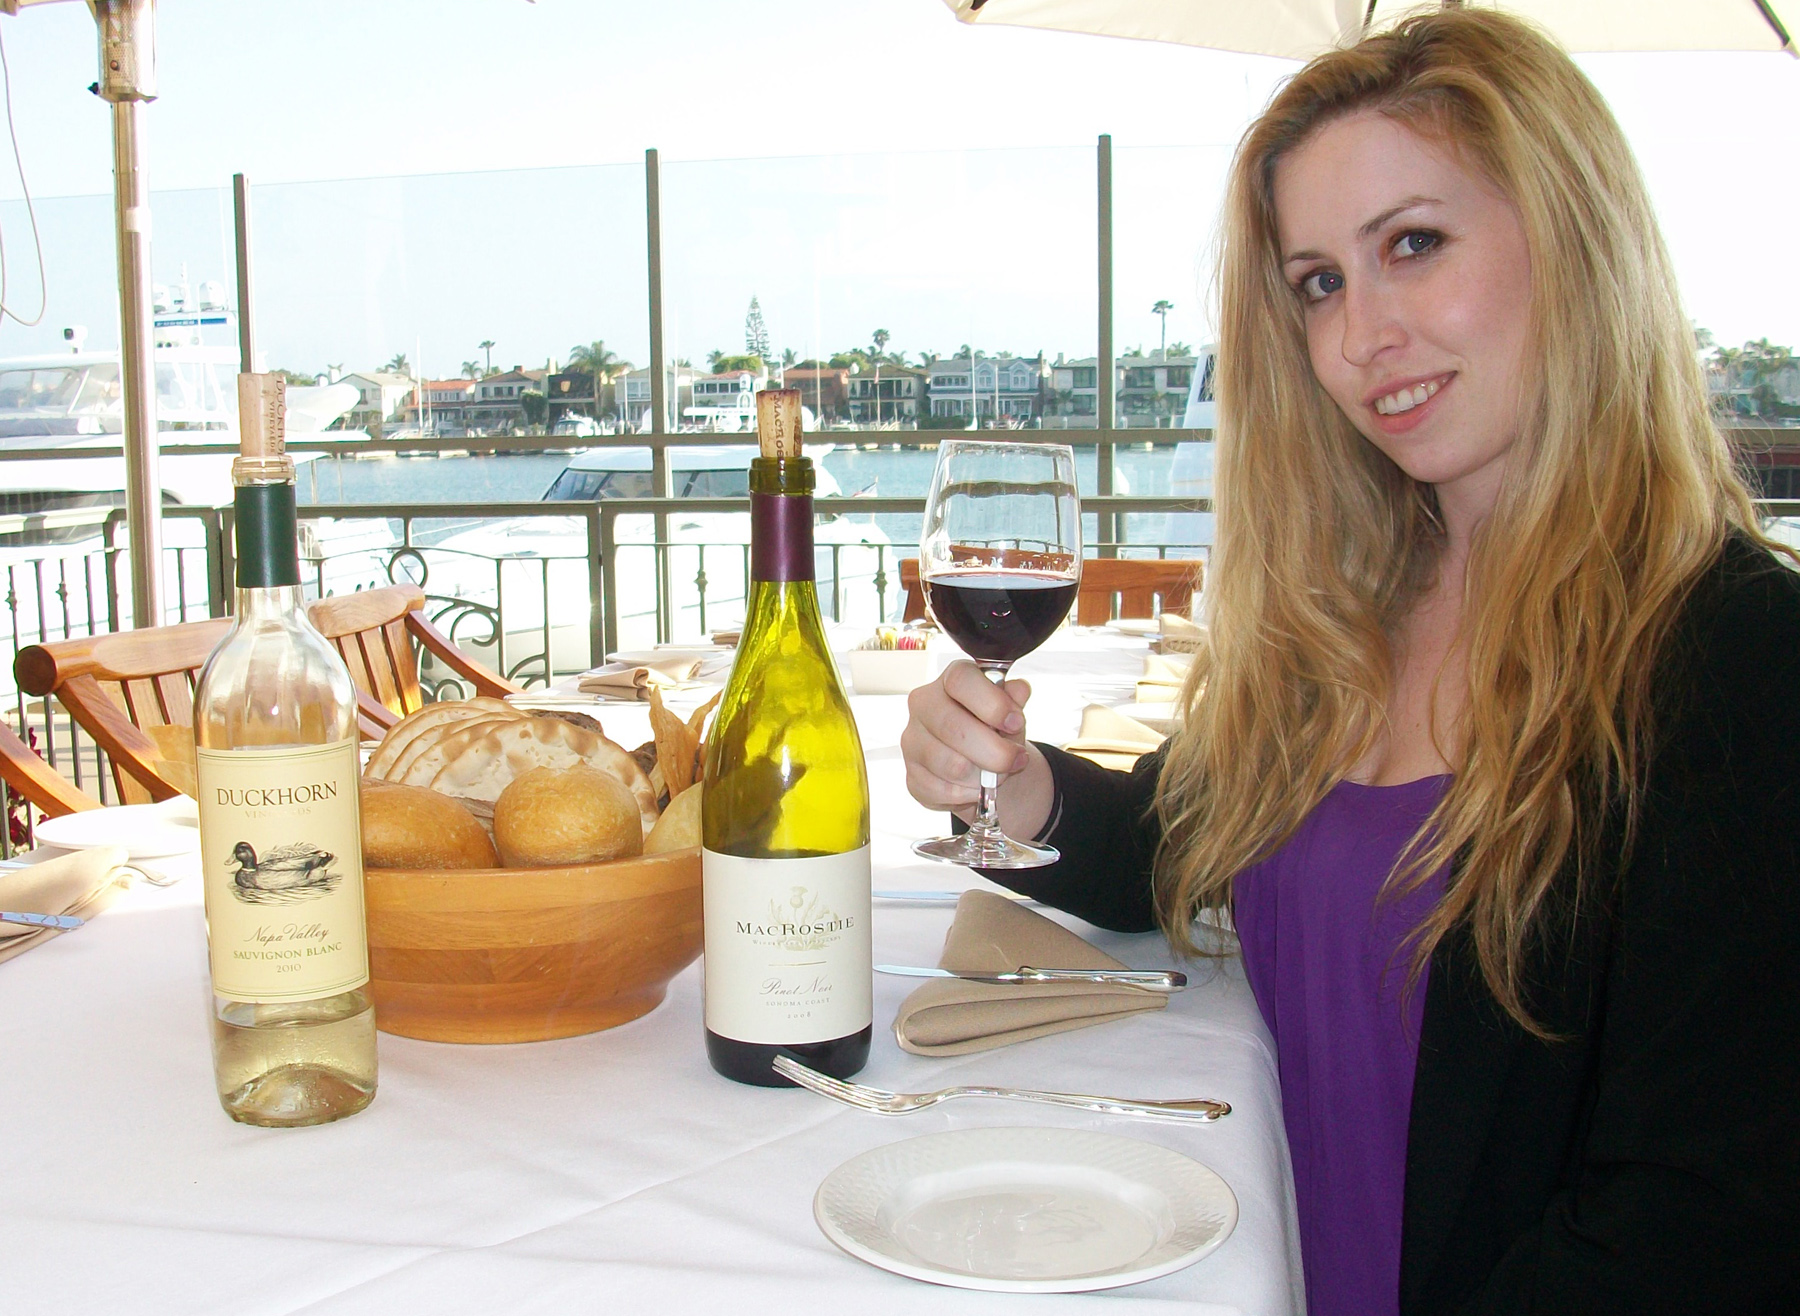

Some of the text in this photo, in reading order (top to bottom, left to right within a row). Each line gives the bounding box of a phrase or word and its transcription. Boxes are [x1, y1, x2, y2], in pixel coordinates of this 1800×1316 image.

[216, 780, 337, 806] DUCKHORN
[243, 923, 330, 947] Napa Valley
[233, 941, 342, 960] SAUVIGNON BLANC
[277, 963, 302, 973] 2010
[759, 974, 833, 995] Pinot Noir
[805, 997, 830, 1006] COAST
[787, 1011, 811, 1019] 2008
